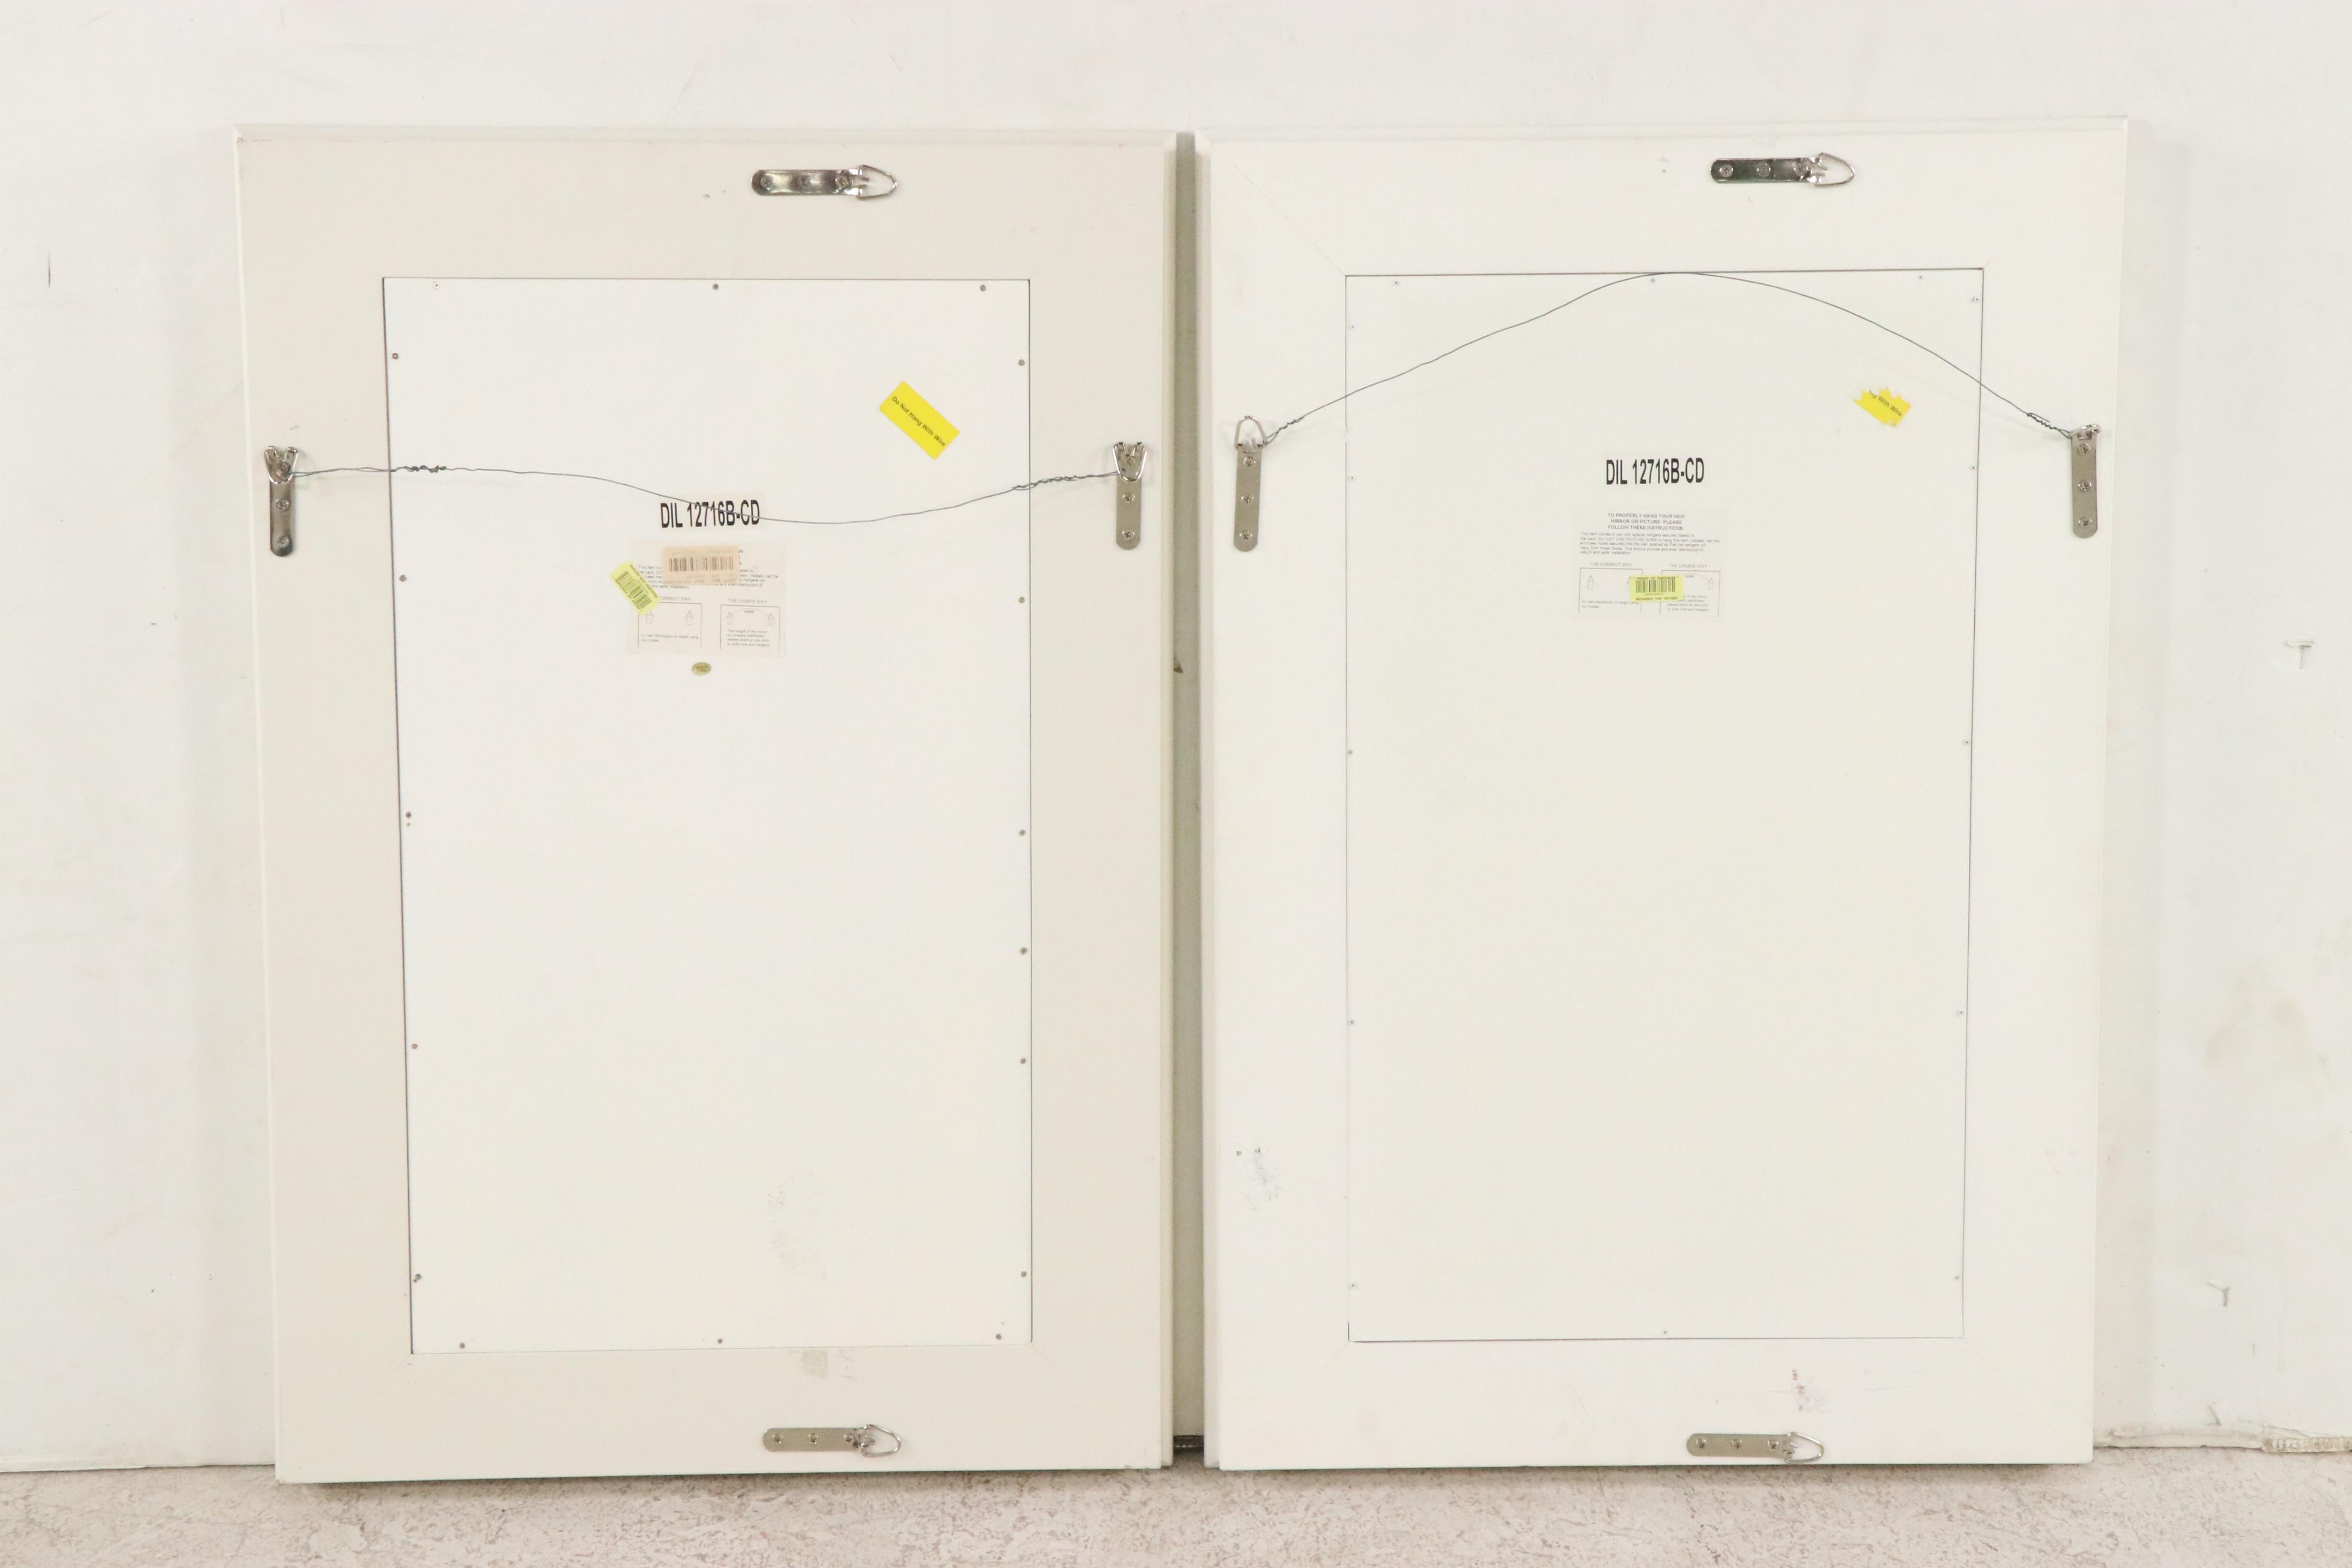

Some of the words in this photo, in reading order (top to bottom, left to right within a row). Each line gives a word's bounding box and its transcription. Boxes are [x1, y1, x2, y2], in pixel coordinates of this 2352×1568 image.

[1878, 396, 1890, 407] With
[1890, 405, 1902, 416] Wire
[891, 396, 900, 405] Do
[900, 403, 909, 413] Not
[909, 412, 922, 426] Hang
[922, 424, 933, 436] With
[933, 434, 945, 446] Wire
[1606, 459, 1628, 485] DIL
[1632, 457, 1704, 484] 12716B-CD
[661, 502, 683, 528] DIL
[687, 499, 760, 527] 12716B-CD
